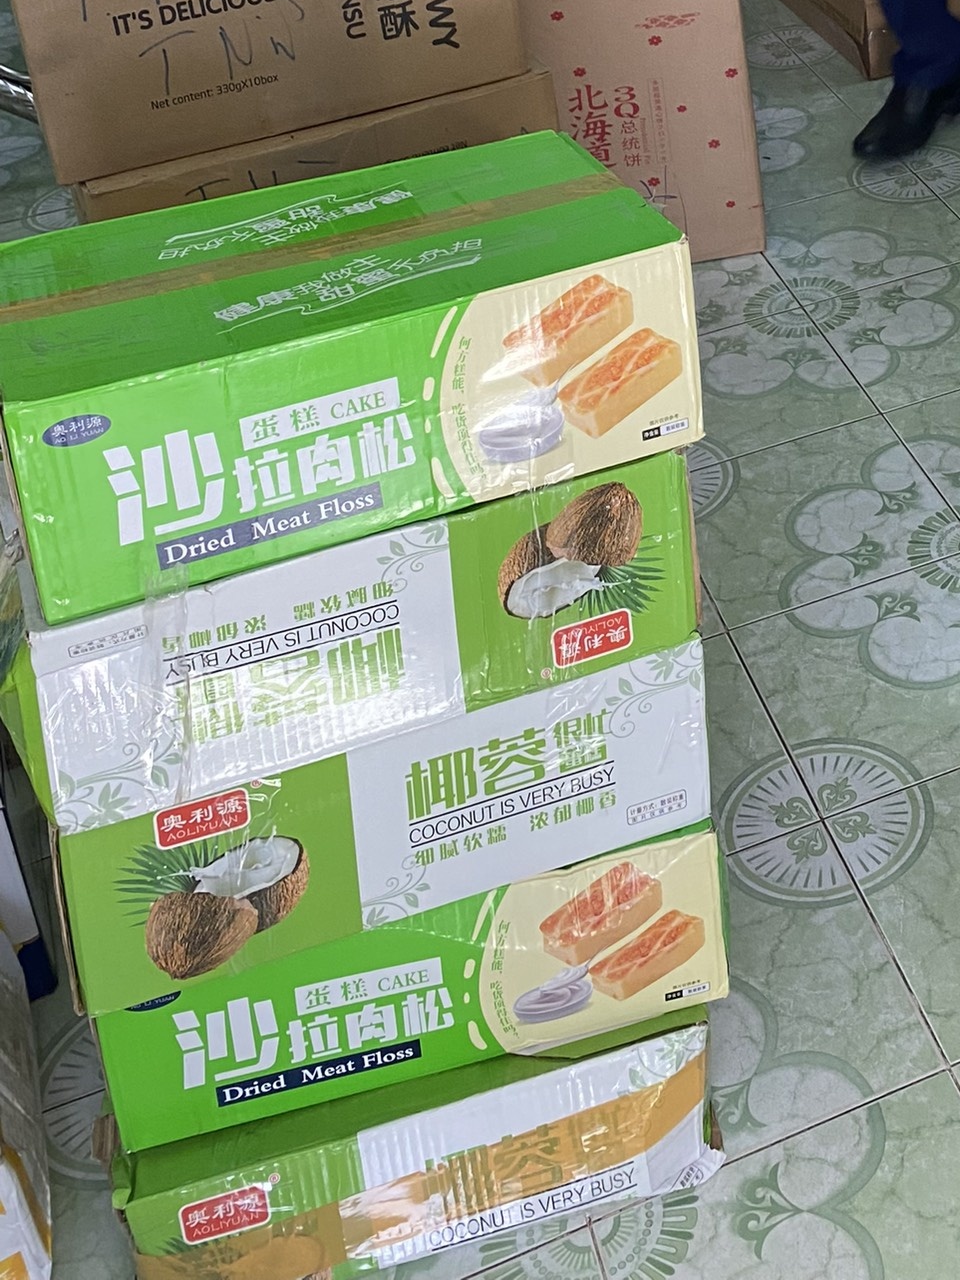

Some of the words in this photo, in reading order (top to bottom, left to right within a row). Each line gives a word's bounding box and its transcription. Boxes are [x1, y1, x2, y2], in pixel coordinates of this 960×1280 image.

[112, 9, 153, 36] IT'S
[150, 97, 171, 110] Net
[172, 86, 214, 106] content:
[216, 73, 279, 96] 330gX10box
[613, 85, 640, 119] 3Q
[620, 120, 643, 168] 总统饼
[51, 417, 103, 437] 奥利源
[250, 404, 321, 443] 蛋糕
[330, 390, 387, 420] CAKE
[102, 412, 418, 547] 沙拉肉松
[163, 533, 236, 566] Dried
[251, 511, 312, 541] Meat
[317, 493, 375, 521] Floss
[284, 631, 302, 646] IS
[306, 603, 400, 644] COCONUT
[166, 651, 220, 679] BUSY
[225, 637, 281, 660] VERY
[405, 727, 546, 821] 椰蓉
[160, 797, 243, 833] 奥利源
[409, 803, 496, 844] COCONUT
[500, 799, 515, 816] IS
[518, 781, 566, 811] VERY
[570, 766, 615, 794] BUSY
[167, 814, 238, 842] AOLIYUAN
[414, 824, 508, 867] 细腻软糯
[528, 789, 617, 833] 浓郁椰香
[304, 978, 369, 1010] 蛋糕
[377, 968, 430, 993] CAKE
[171, 987, 456, 1090] 沙拉肉松
[222, 1074, 287, 1104] Dried
[301, 1059, 356, 1083] Meat
[361, 1046, 414, 1069] Floss
[185, 1193, 264, 1228] 奥利源
[192, 1211, 260, 1238] AOLIYUAN
[428, 1207, 514, 1247] COCONUT
[519, 1202, 536, 1220] IS
[539, 1184, 586, 1215] VERY
[590, 1168, 636, 1197] BUSY
